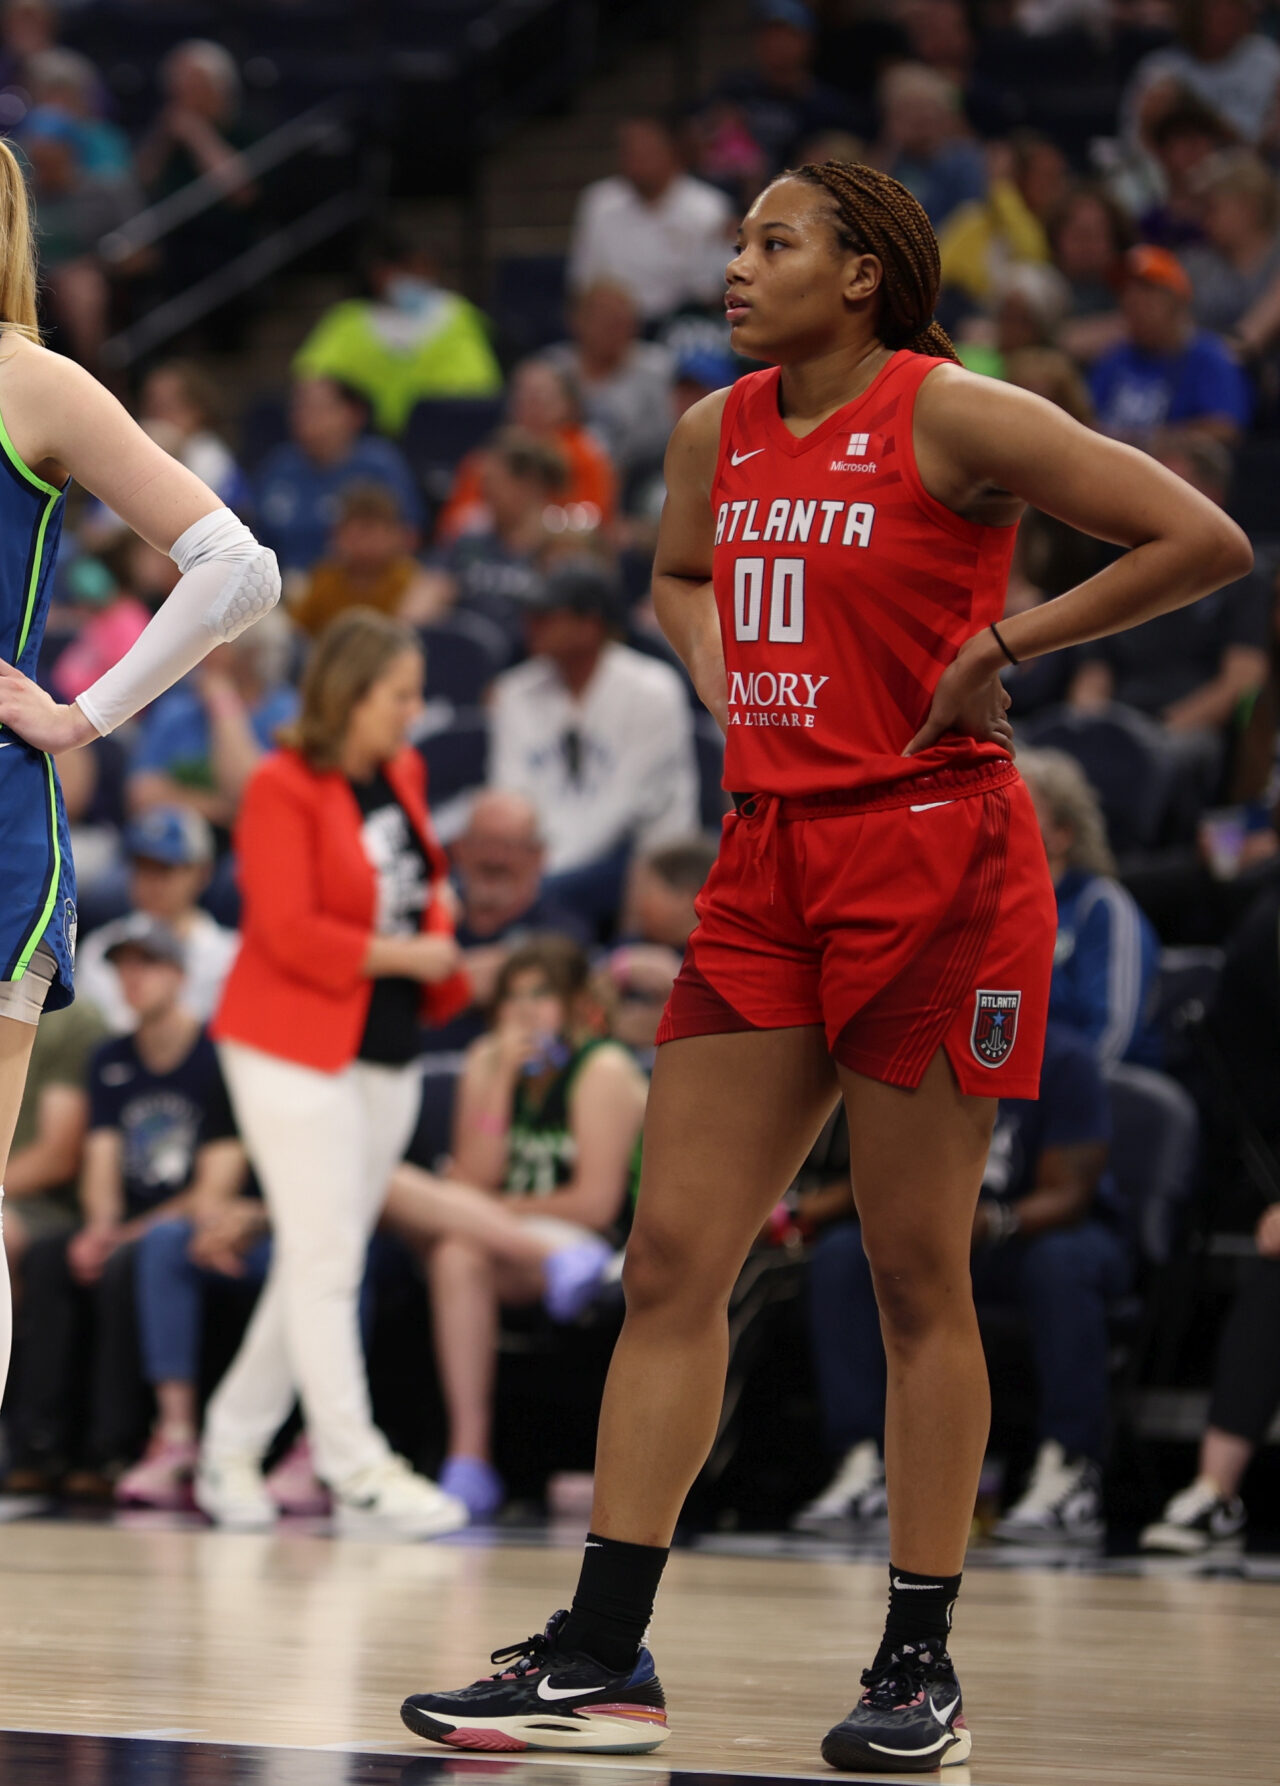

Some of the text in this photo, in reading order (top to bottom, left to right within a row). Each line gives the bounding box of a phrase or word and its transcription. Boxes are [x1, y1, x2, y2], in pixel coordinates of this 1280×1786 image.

[830, 460, 876, 473] Microsoft
[714, 498, 876, 548] ATLANTA
[734, 557, 805, 643] 00
[728, 671, 830, 709] MORY
[981, 996, 1017, 1008] ATLANTA
